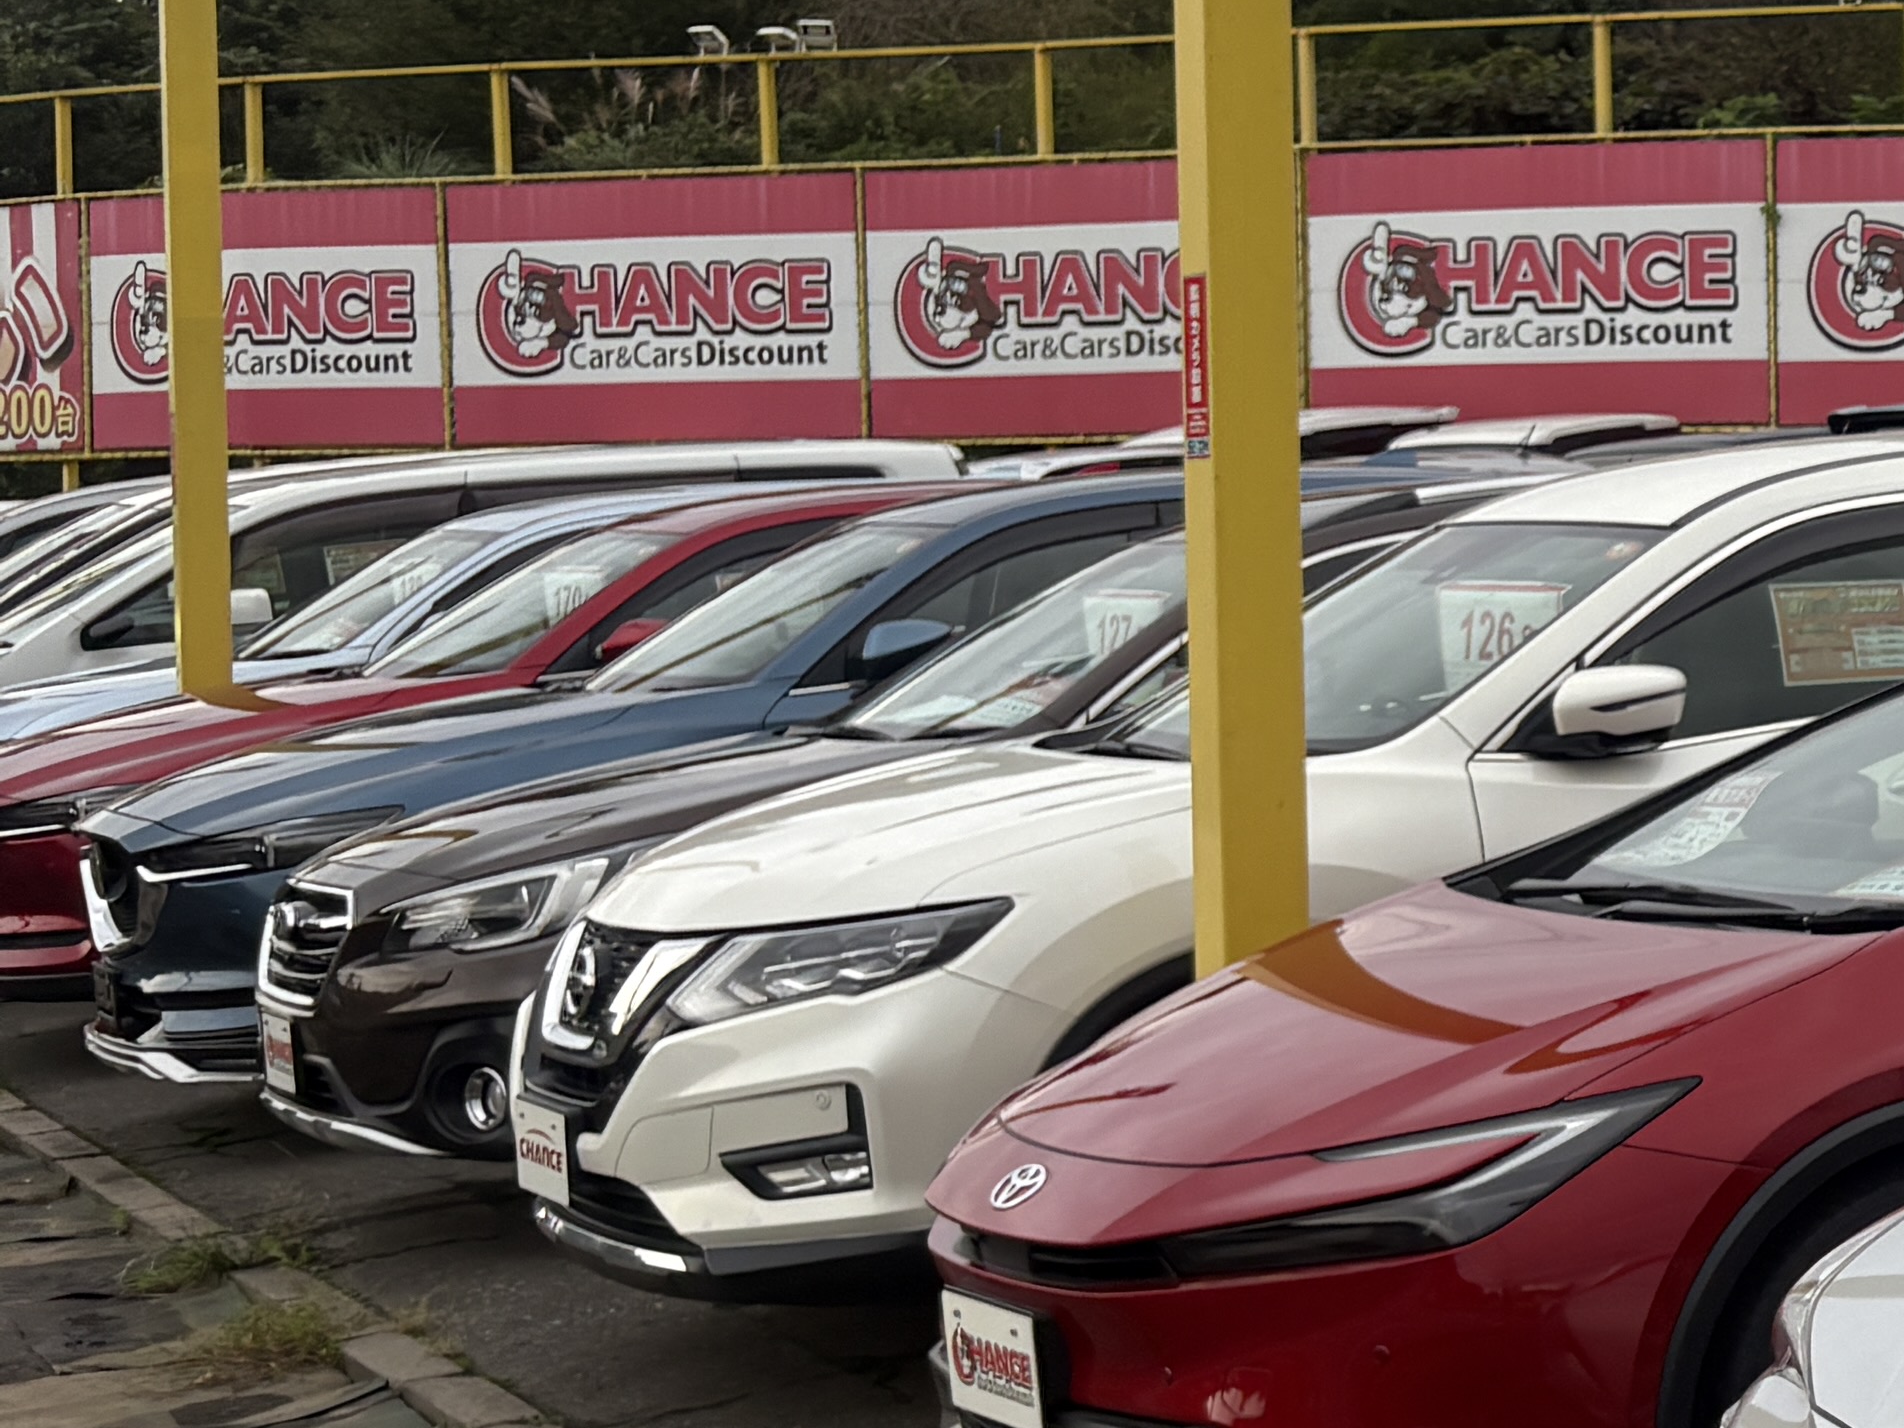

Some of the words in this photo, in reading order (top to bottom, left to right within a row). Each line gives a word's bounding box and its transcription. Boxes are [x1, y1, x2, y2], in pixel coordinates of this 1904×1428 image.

[111, 269, 416, 384] CANCE
[476, 258, 832, 377] CHANCE
[894, 245, 1181, 369] CHAN
[1338, 231, 1738, 358] CHANCE
[520, 1137, 562, 1174] CHANCE
